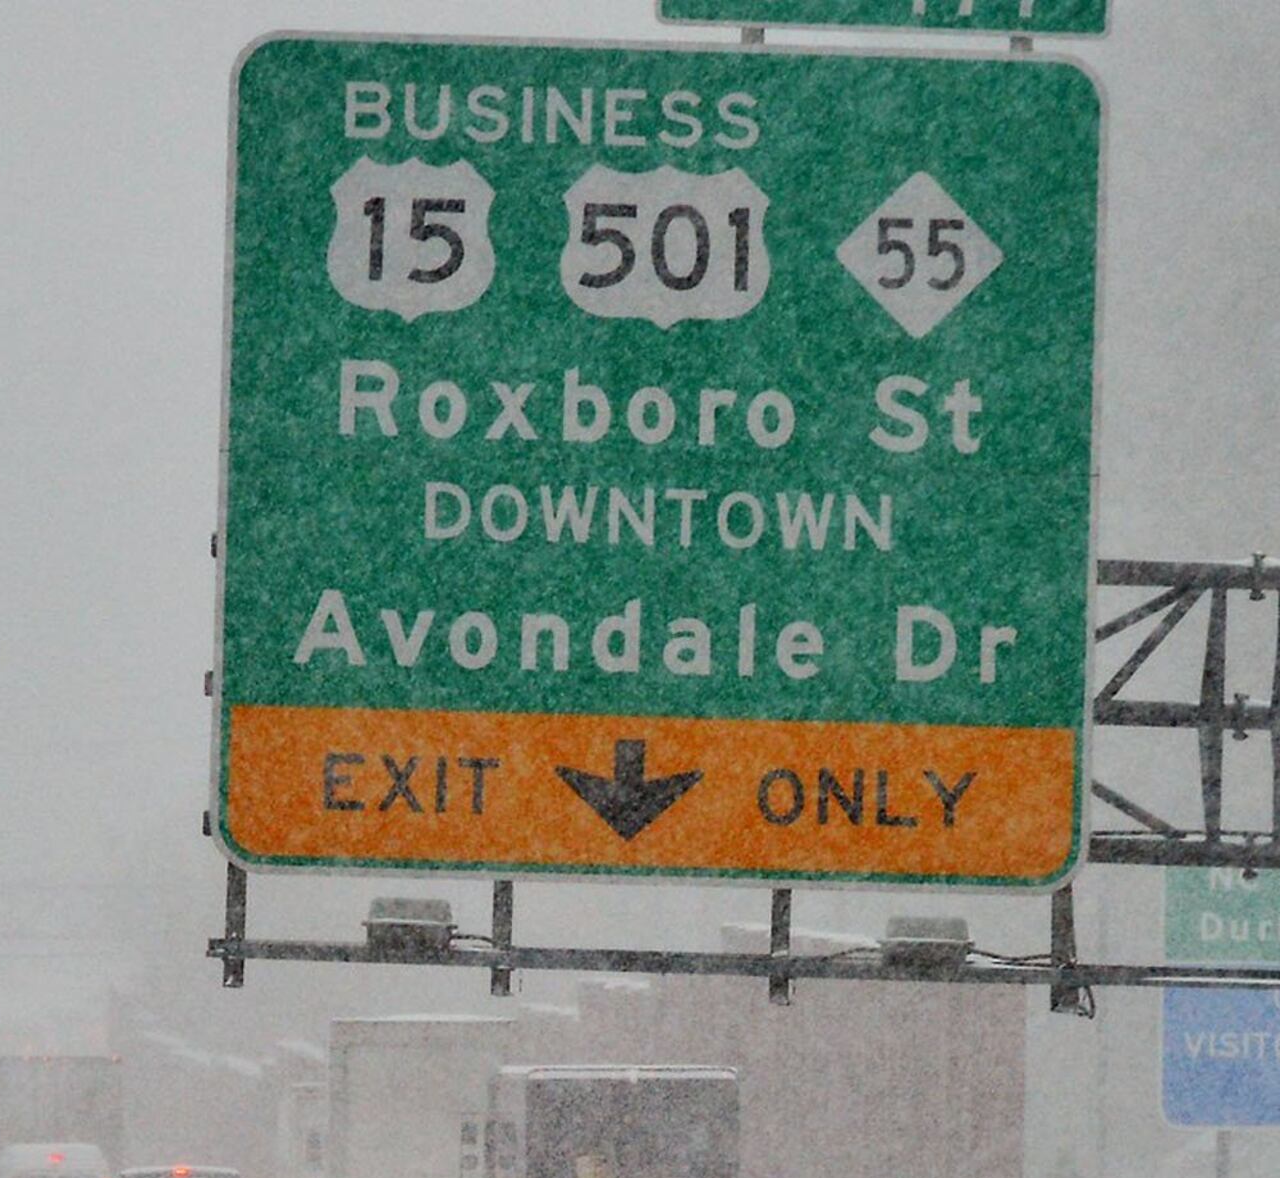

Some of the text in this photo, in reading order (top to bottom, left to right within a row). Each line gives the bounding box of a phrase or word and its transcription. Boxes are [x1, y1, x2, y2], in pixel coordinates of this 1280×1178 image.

[344, 80, 761, 150] BUSINESS
[363, 196, 466, 284] 15
[578, 203, 751, 292] 501
[877, 217, 966, 290] 55
[338, 358, 983, 454] Roxboro St
[424, 481, 895, 553] DOWNTOWN
[293, 588, 1020, 685] Avondale Dr
[324, 752, 980, 828] EXIT ONLY
